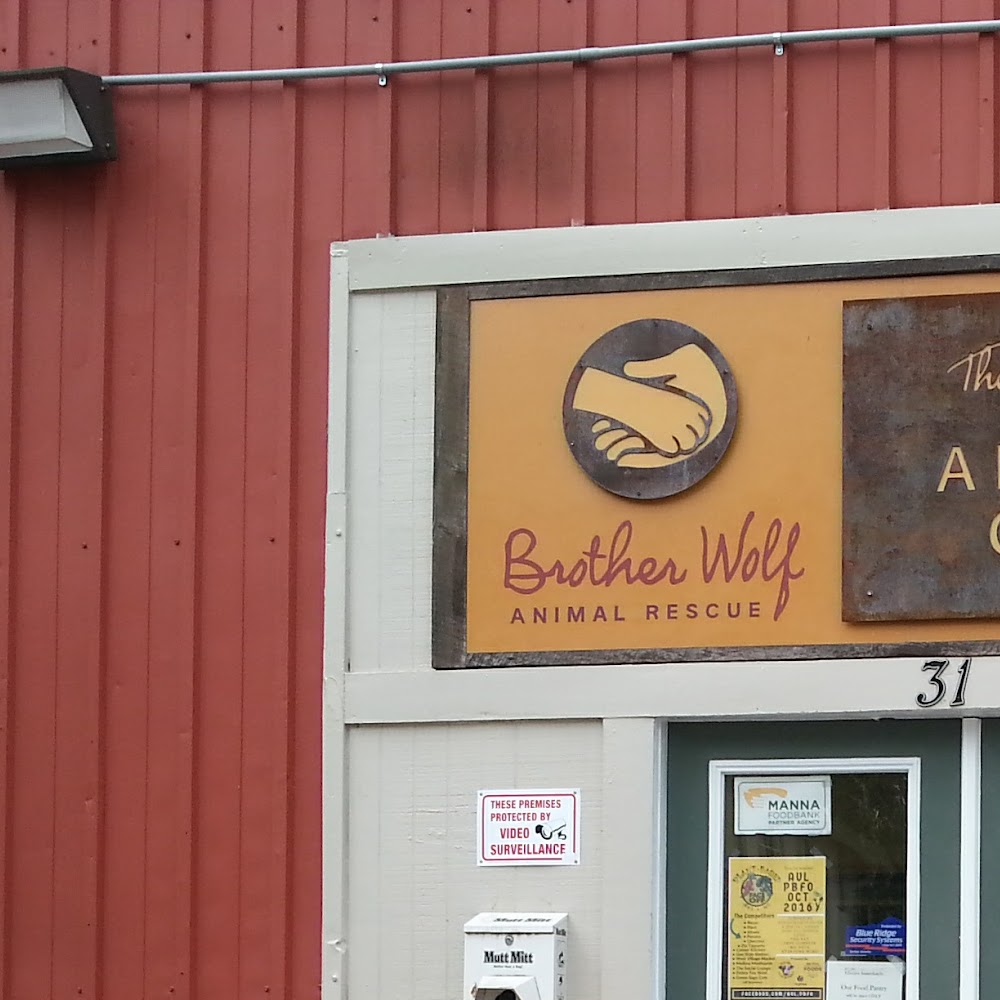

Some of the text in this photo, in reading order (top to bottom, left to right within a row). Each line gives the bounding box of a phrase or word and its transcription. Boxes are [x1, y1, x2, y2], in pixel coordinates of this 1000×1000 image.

[504, 511, 805, 621] Brother Wolf
[511, 602, 761, 624] ANIMAL RESCUE
[916, 657, 973, 707] 31
[490, 800, 561, 809] THESE PREMISES
[768, 800, 820, 810] MANNA
[490, 812, 551, 821] PROTECTED BY
[500, 828, 530, 838] VIDEO
[490, 844, 566, 855] SURVEILLANCE
[788, 892, 808, 902] OCT
[874, 929, 897, 938] Ridge
[484, 950, 534, 964] Mutt Mitt
